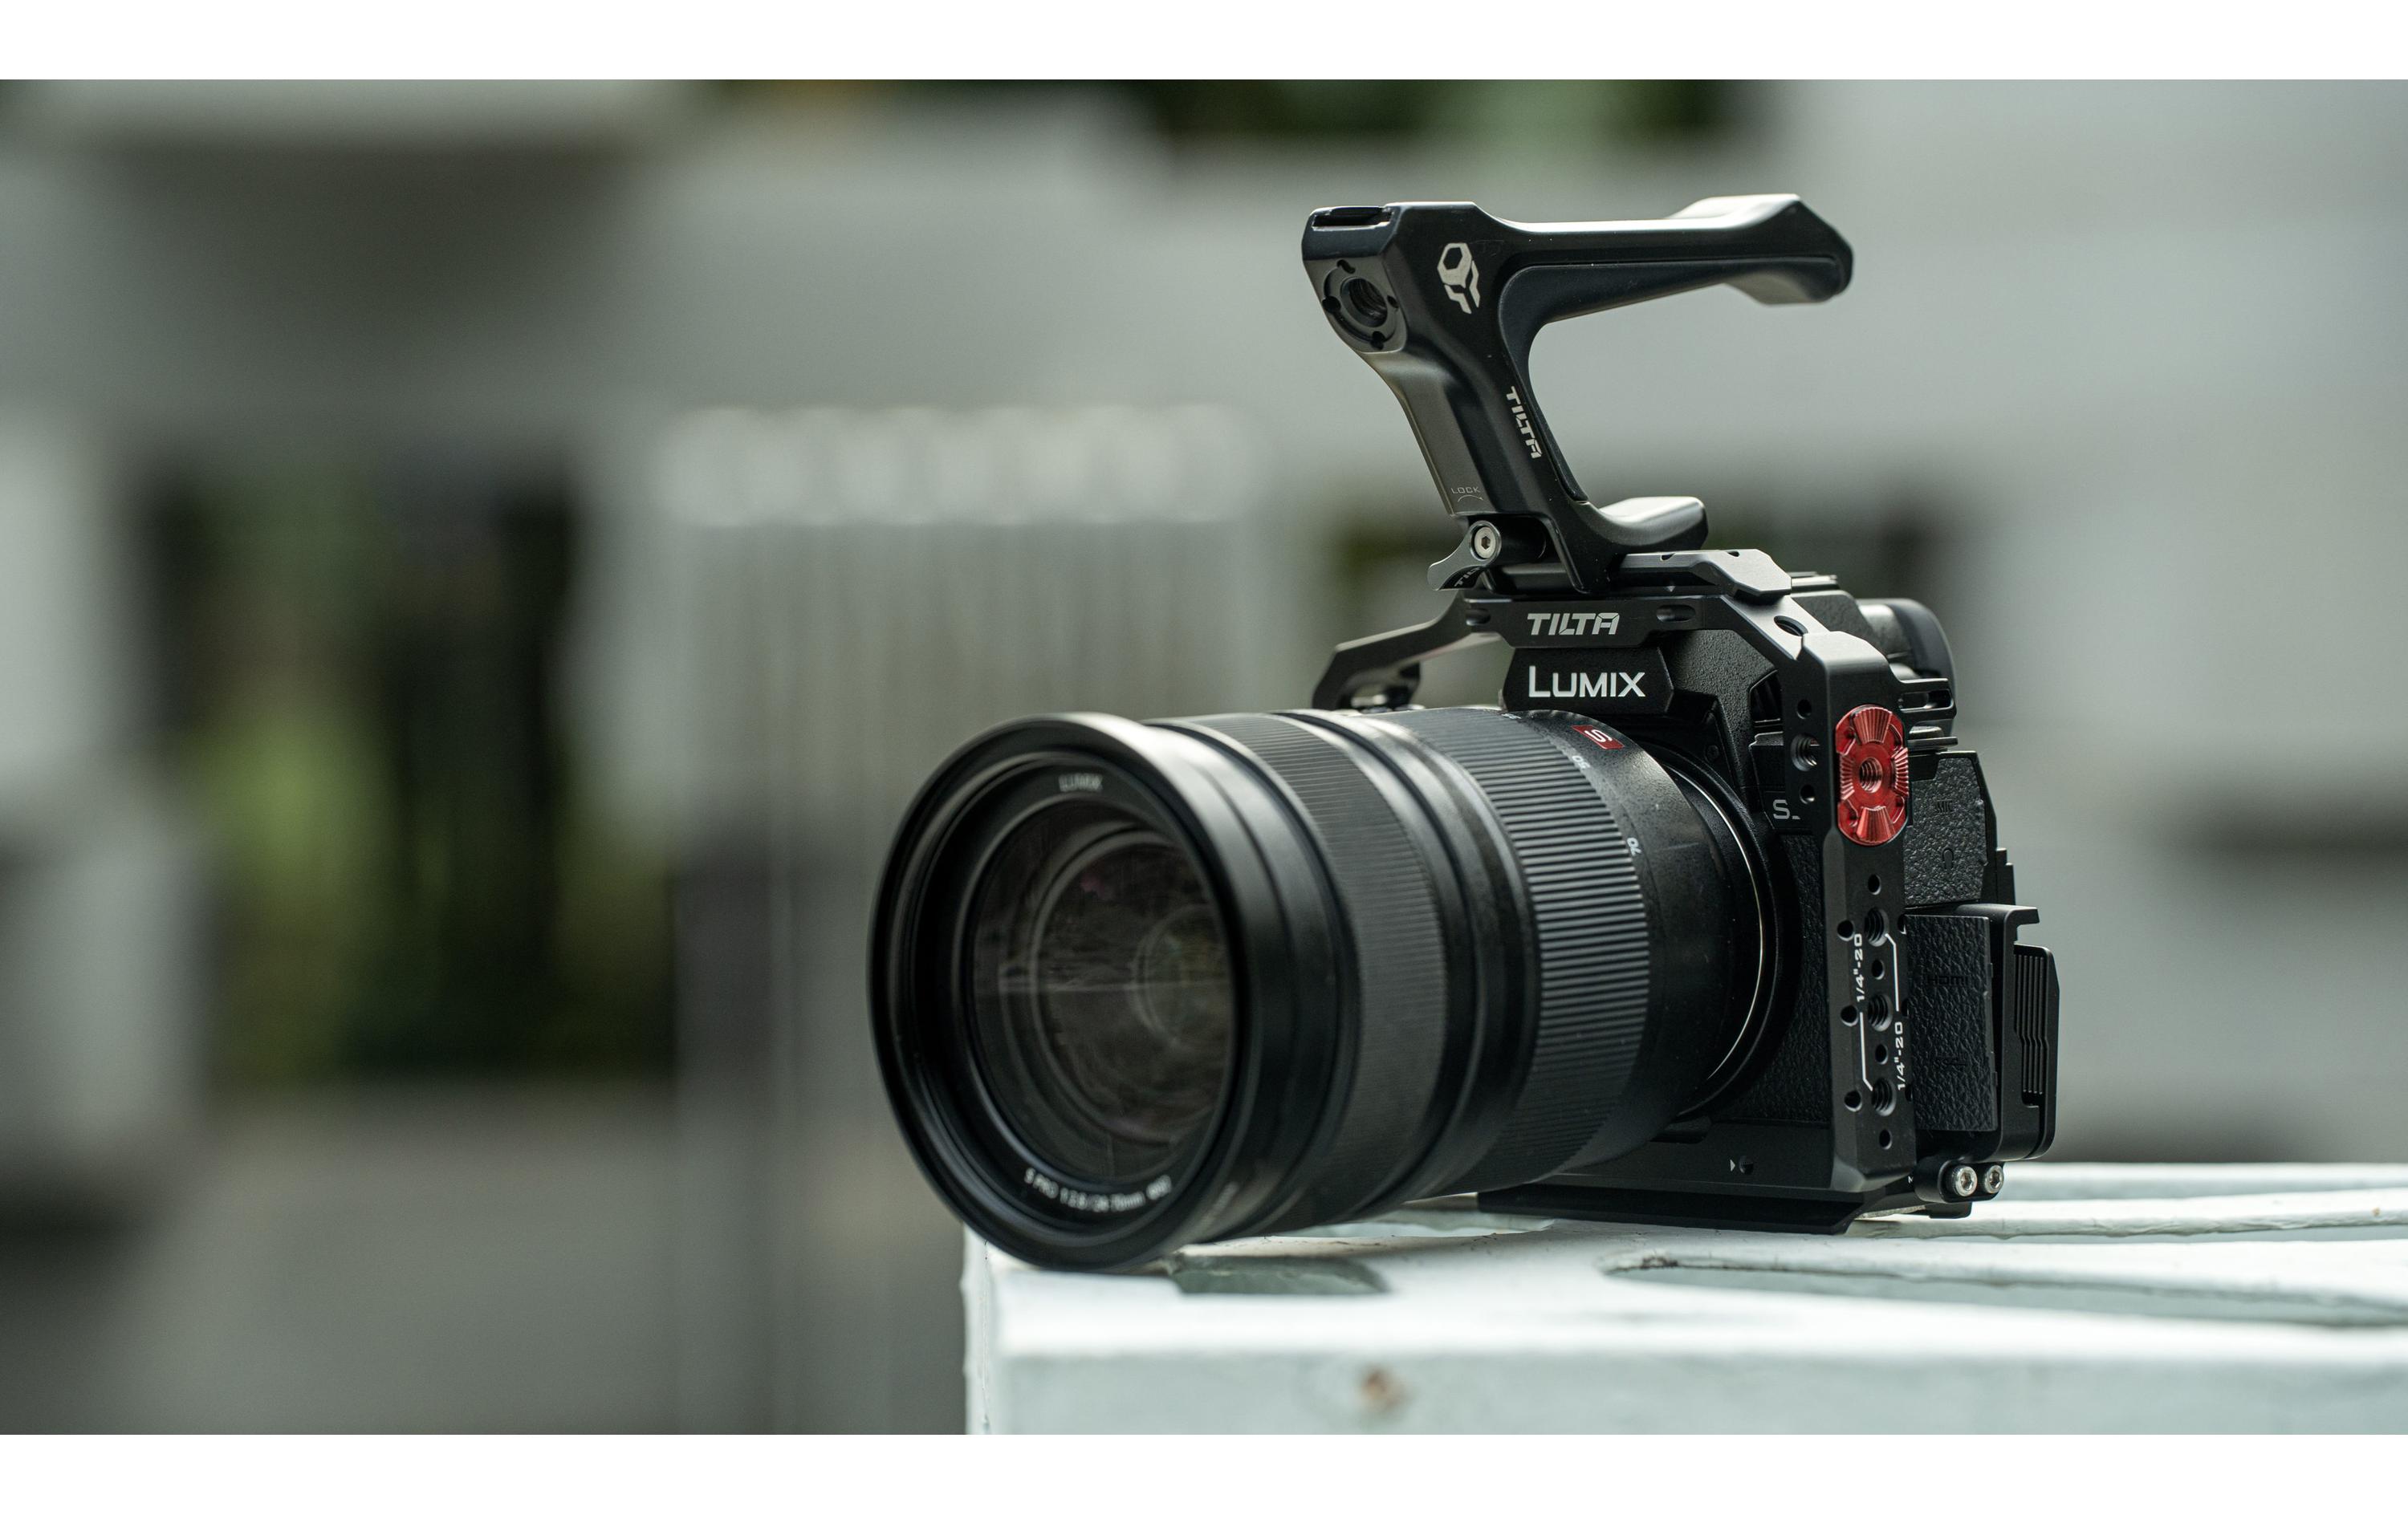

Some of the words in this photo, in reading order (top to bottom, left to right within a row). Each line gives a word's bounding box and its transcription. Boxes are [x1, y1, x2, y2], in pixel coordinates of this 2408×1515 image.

[1506, 385, 1542, 458] TILTA
[1450, 486, 1481, 494] LOCK
[1527, 612, 1620, 636] TILTA
[1853, 933, 1865, 1002] 1/4"-20
[1894, 1022, 1906, 1091] 1/4"-20
